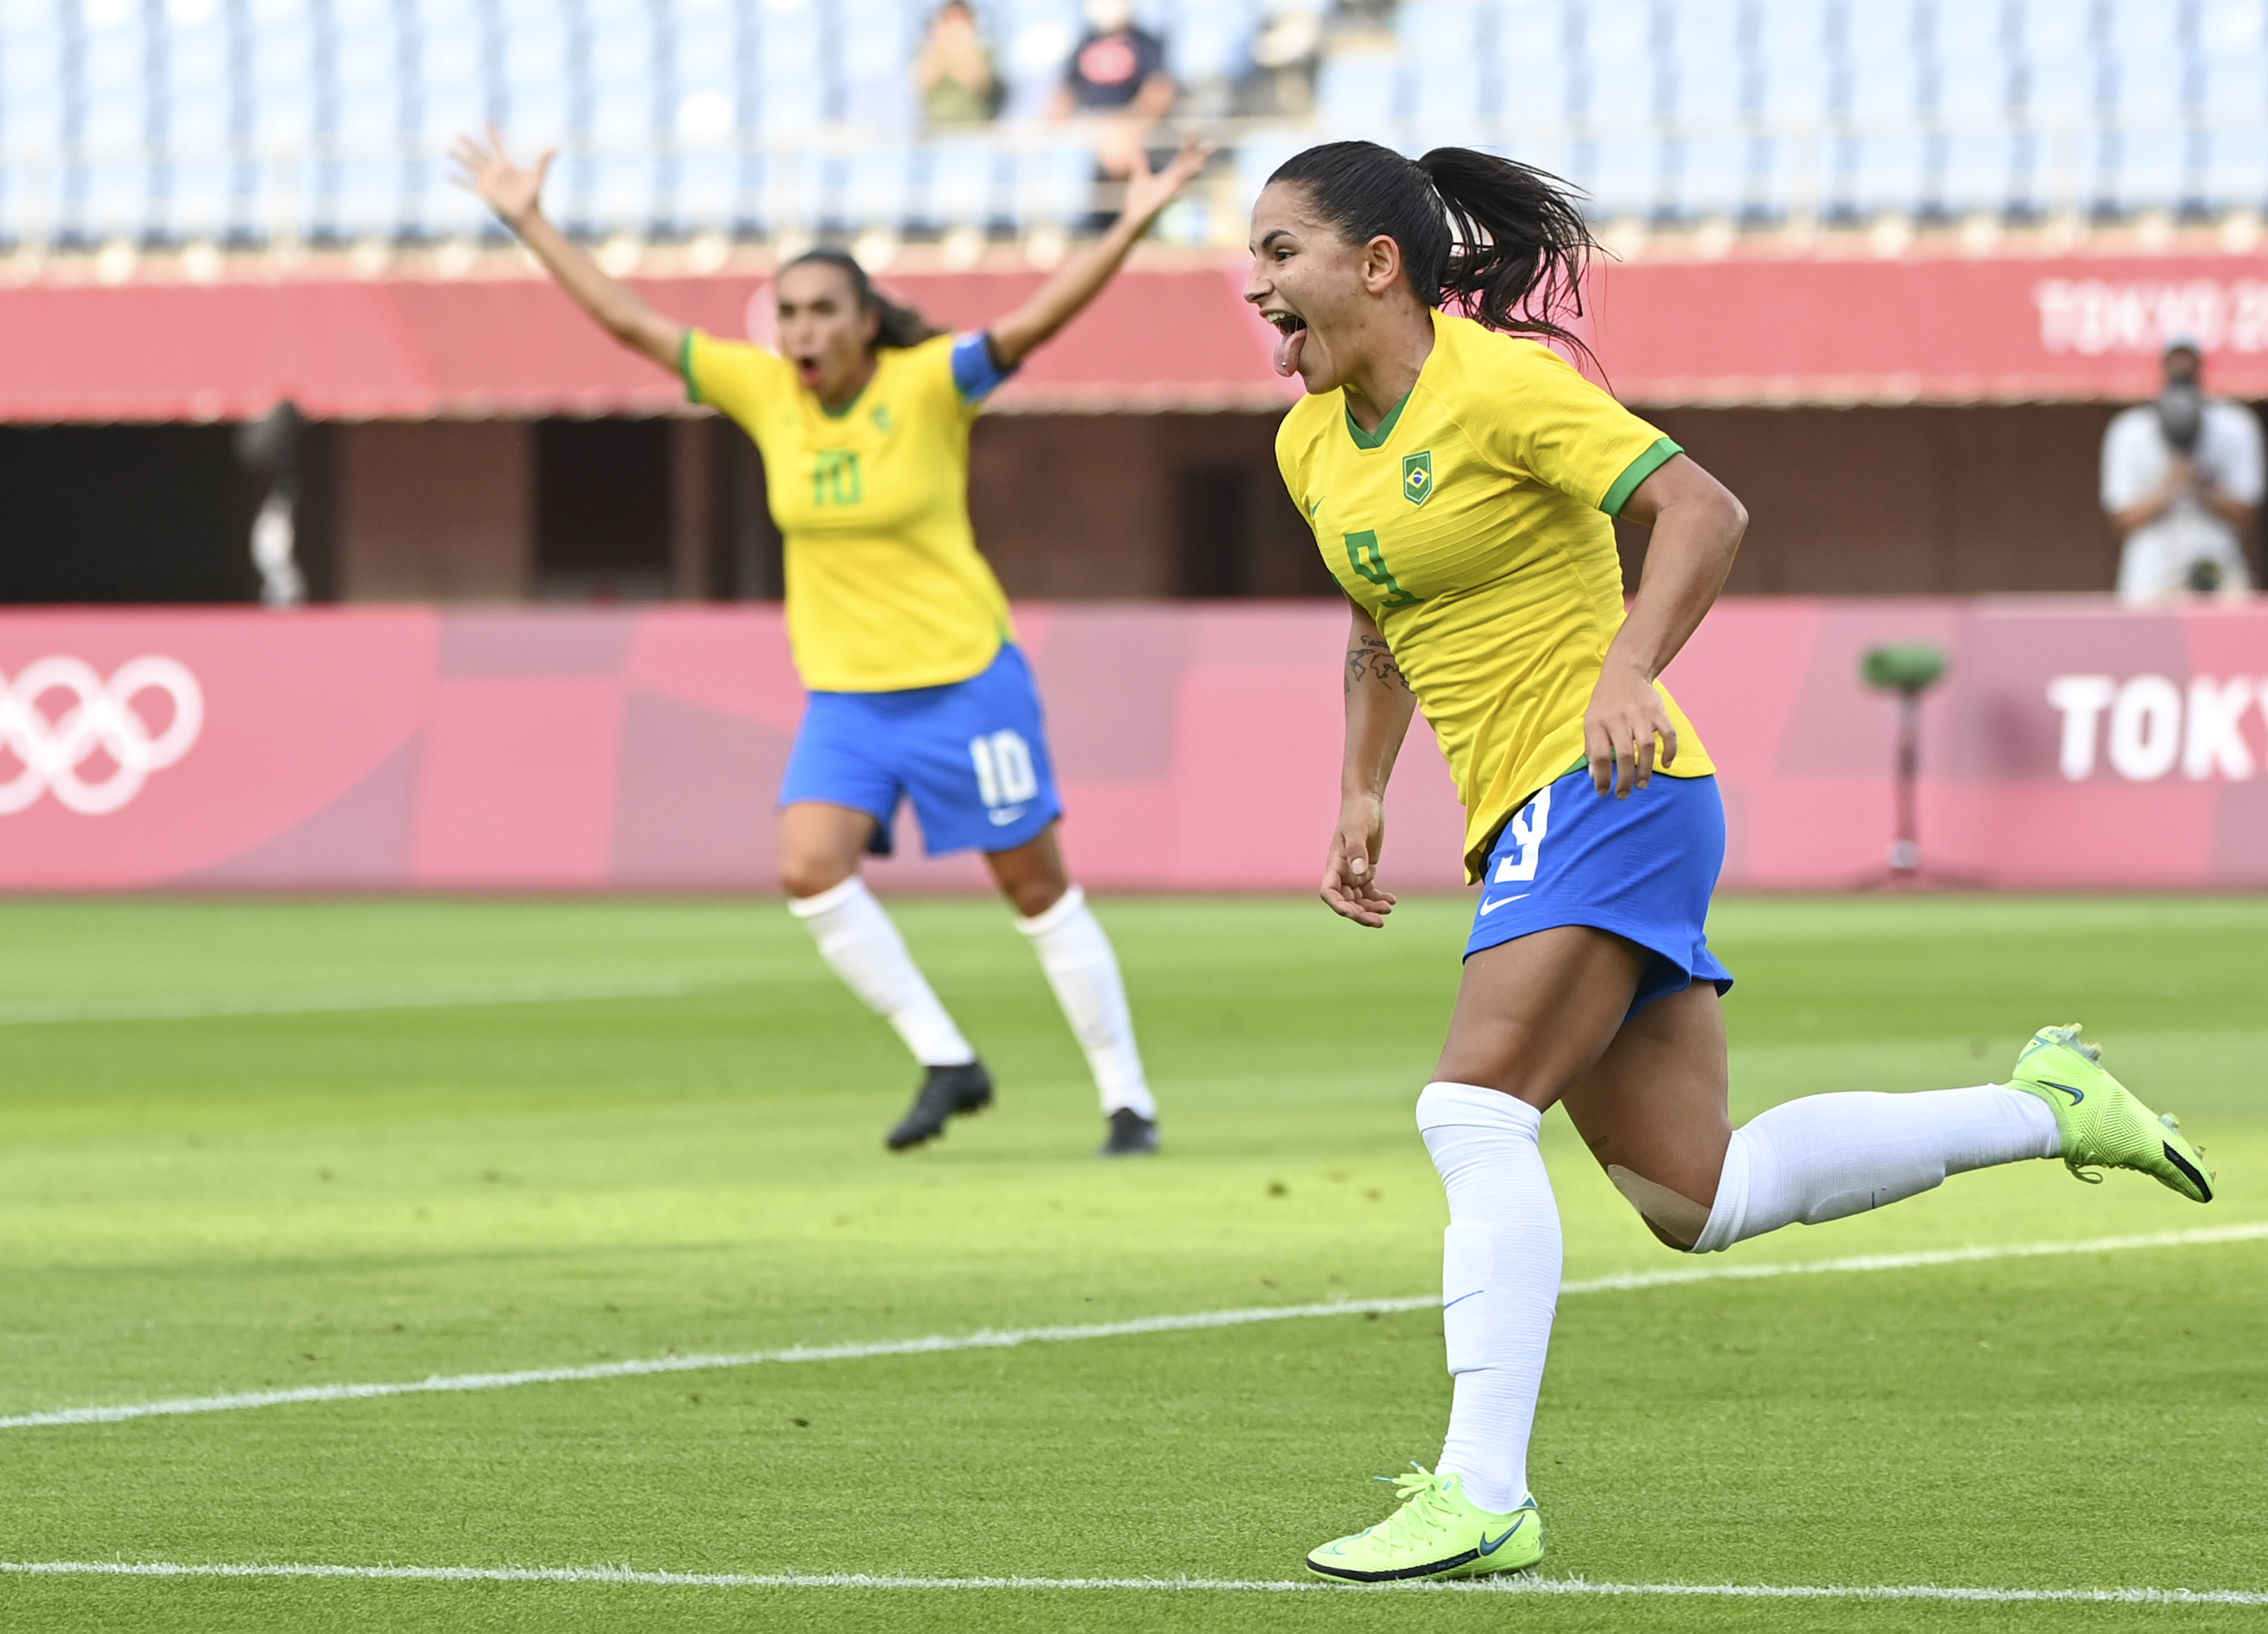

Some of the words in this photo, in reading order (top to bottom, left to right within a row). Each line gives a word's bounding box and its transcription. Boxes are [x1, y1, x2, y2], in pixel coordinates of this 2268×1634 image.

[815, 448, 861, 506] 10
[1344, 529, 1425, 608] 9
[969, 728, 1038, 808] 10
[2047, 674, 2268, 782] TOK
[1493, 784, 1551, 884] 9
